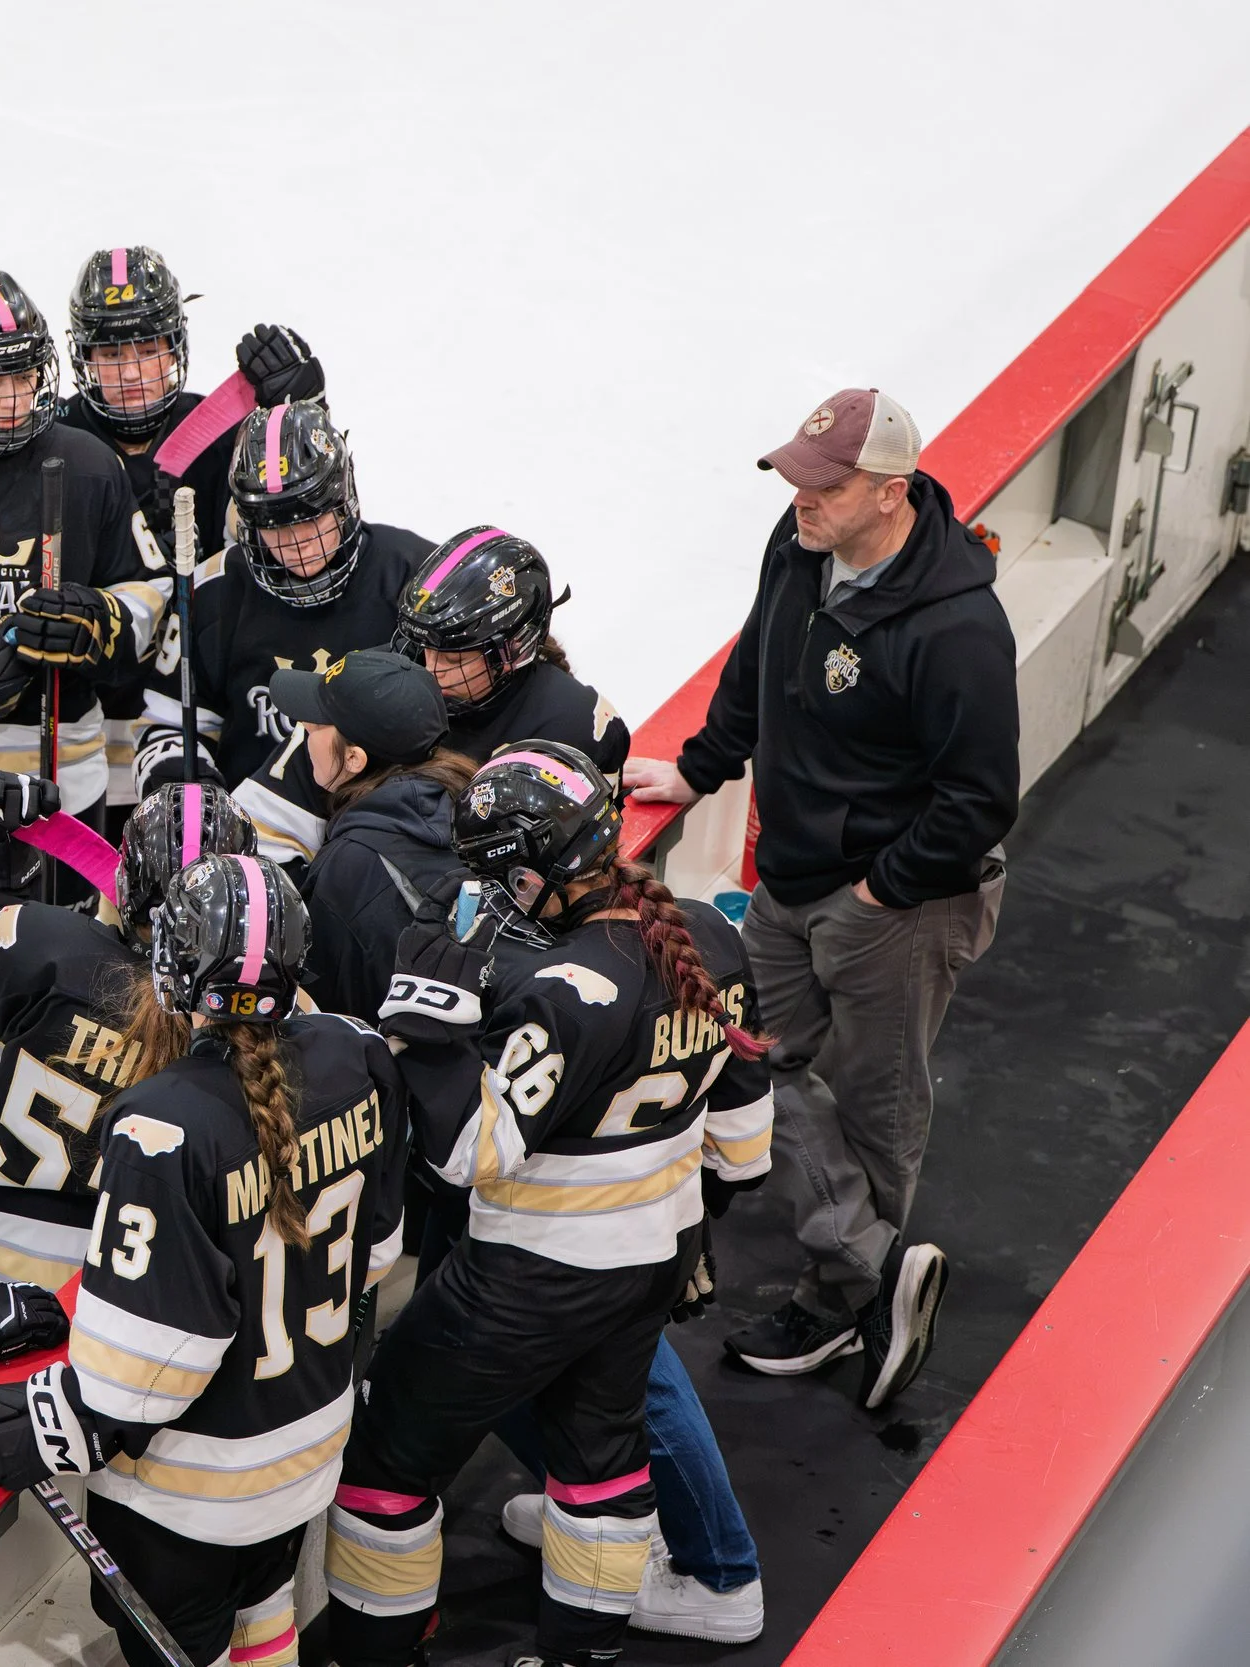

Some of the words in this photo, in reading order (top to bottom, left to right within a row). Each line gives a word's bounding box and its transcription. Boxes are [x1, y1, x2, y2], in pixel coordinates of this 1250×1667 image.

[104, 284, 135, 305] 24
[1, 568, 30, 578] CITY
[413, 588, 431, 613] 7
[824, 649, 861, 687] ROYALS
[487, 843, 517, 858] CCM
[230, 991, 258, 1015] 13
[86, 1191, 158, 1282] 13
[253, 1169, 366, 1381] 13
[34, 1480, 120, 1576] BAUE
